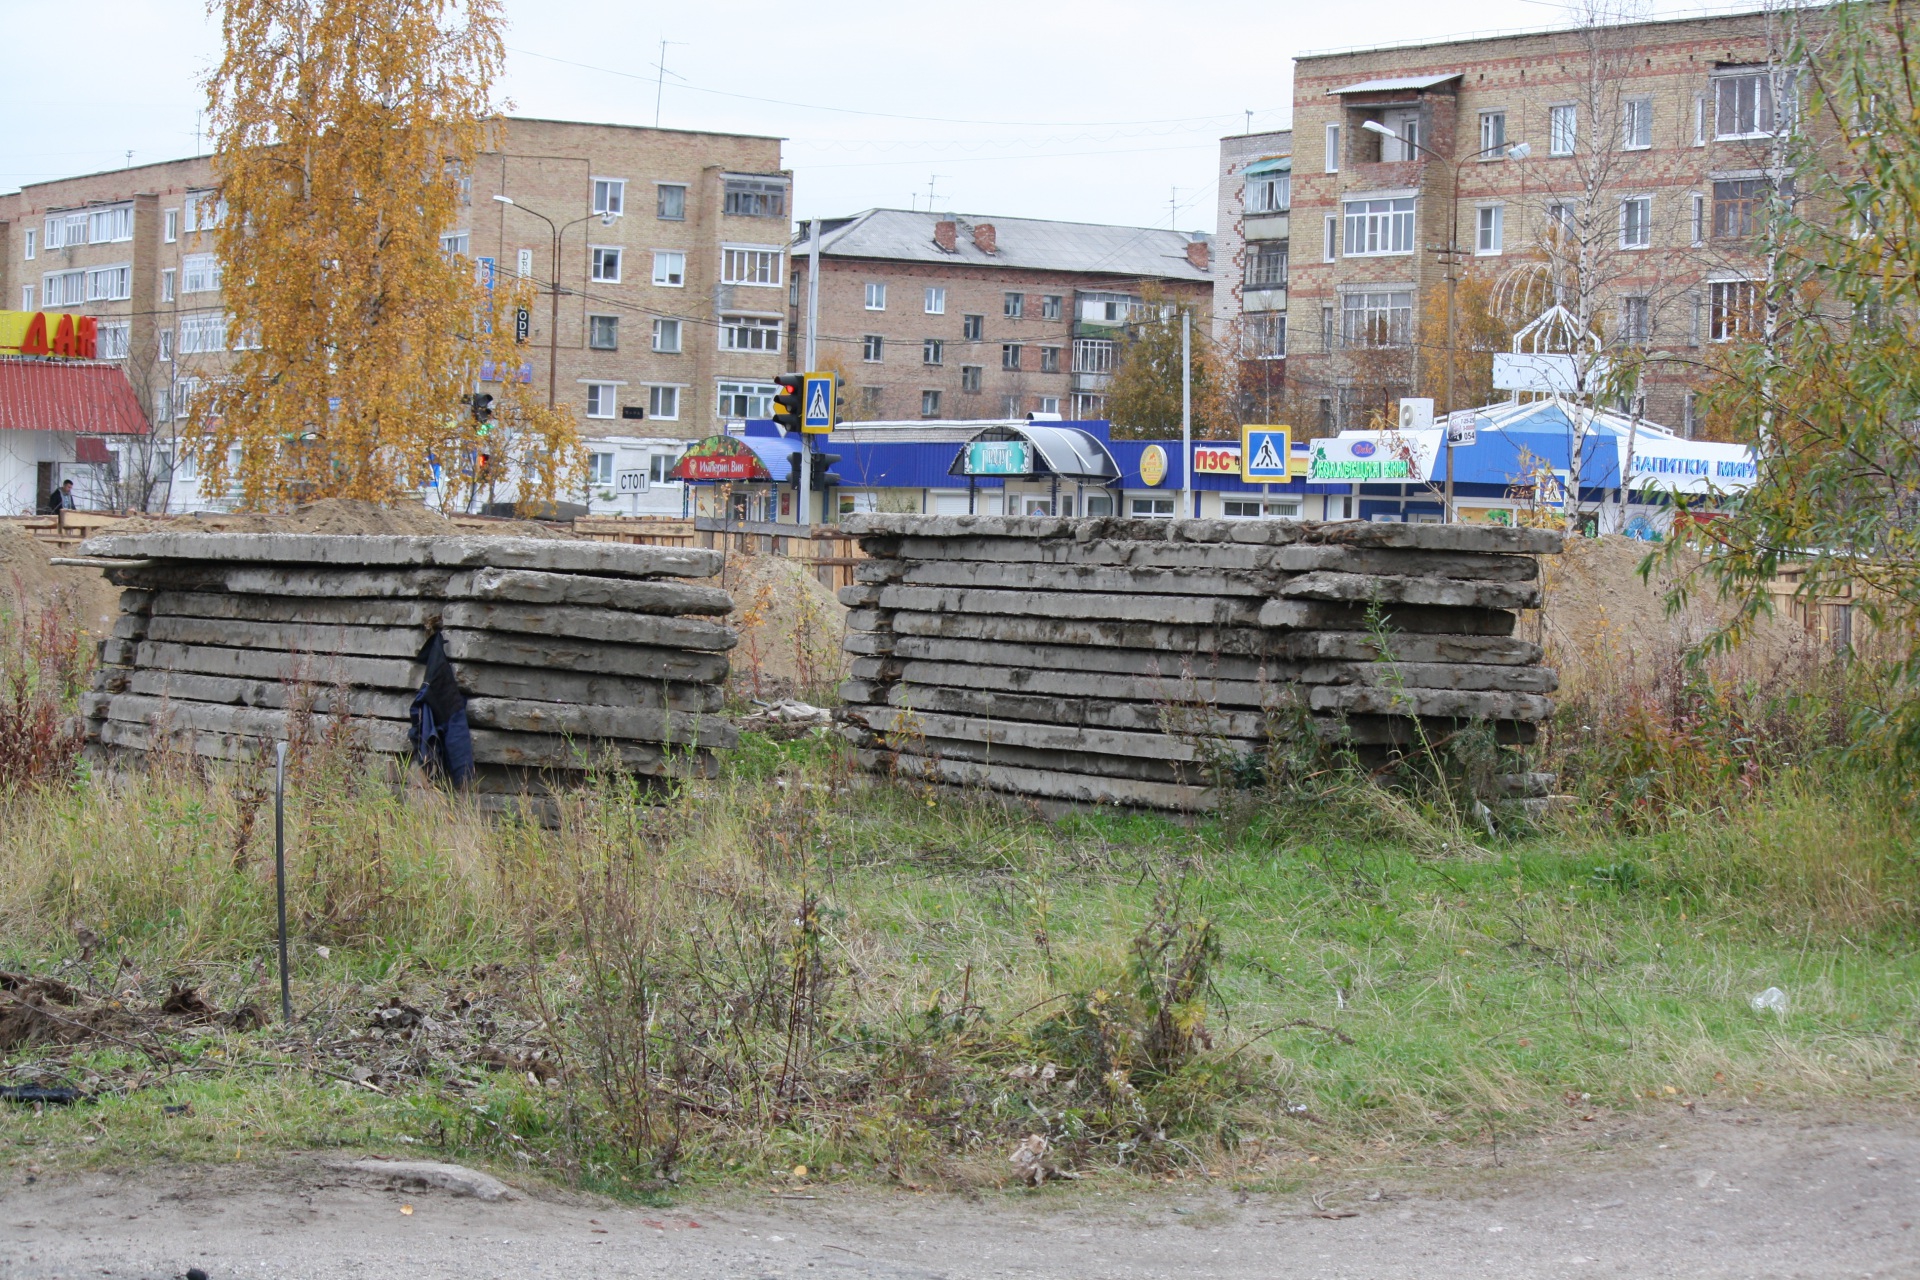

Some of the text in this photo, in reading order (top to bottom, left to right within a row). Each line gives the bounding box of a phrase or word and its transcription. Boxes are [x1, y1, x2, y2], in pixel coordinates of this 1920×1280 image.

[1464, 432, 1475, 441] 054
[1631, 455, 1708, 476] НАПИТКИ
[621, 473, 645, 489] СТОП
